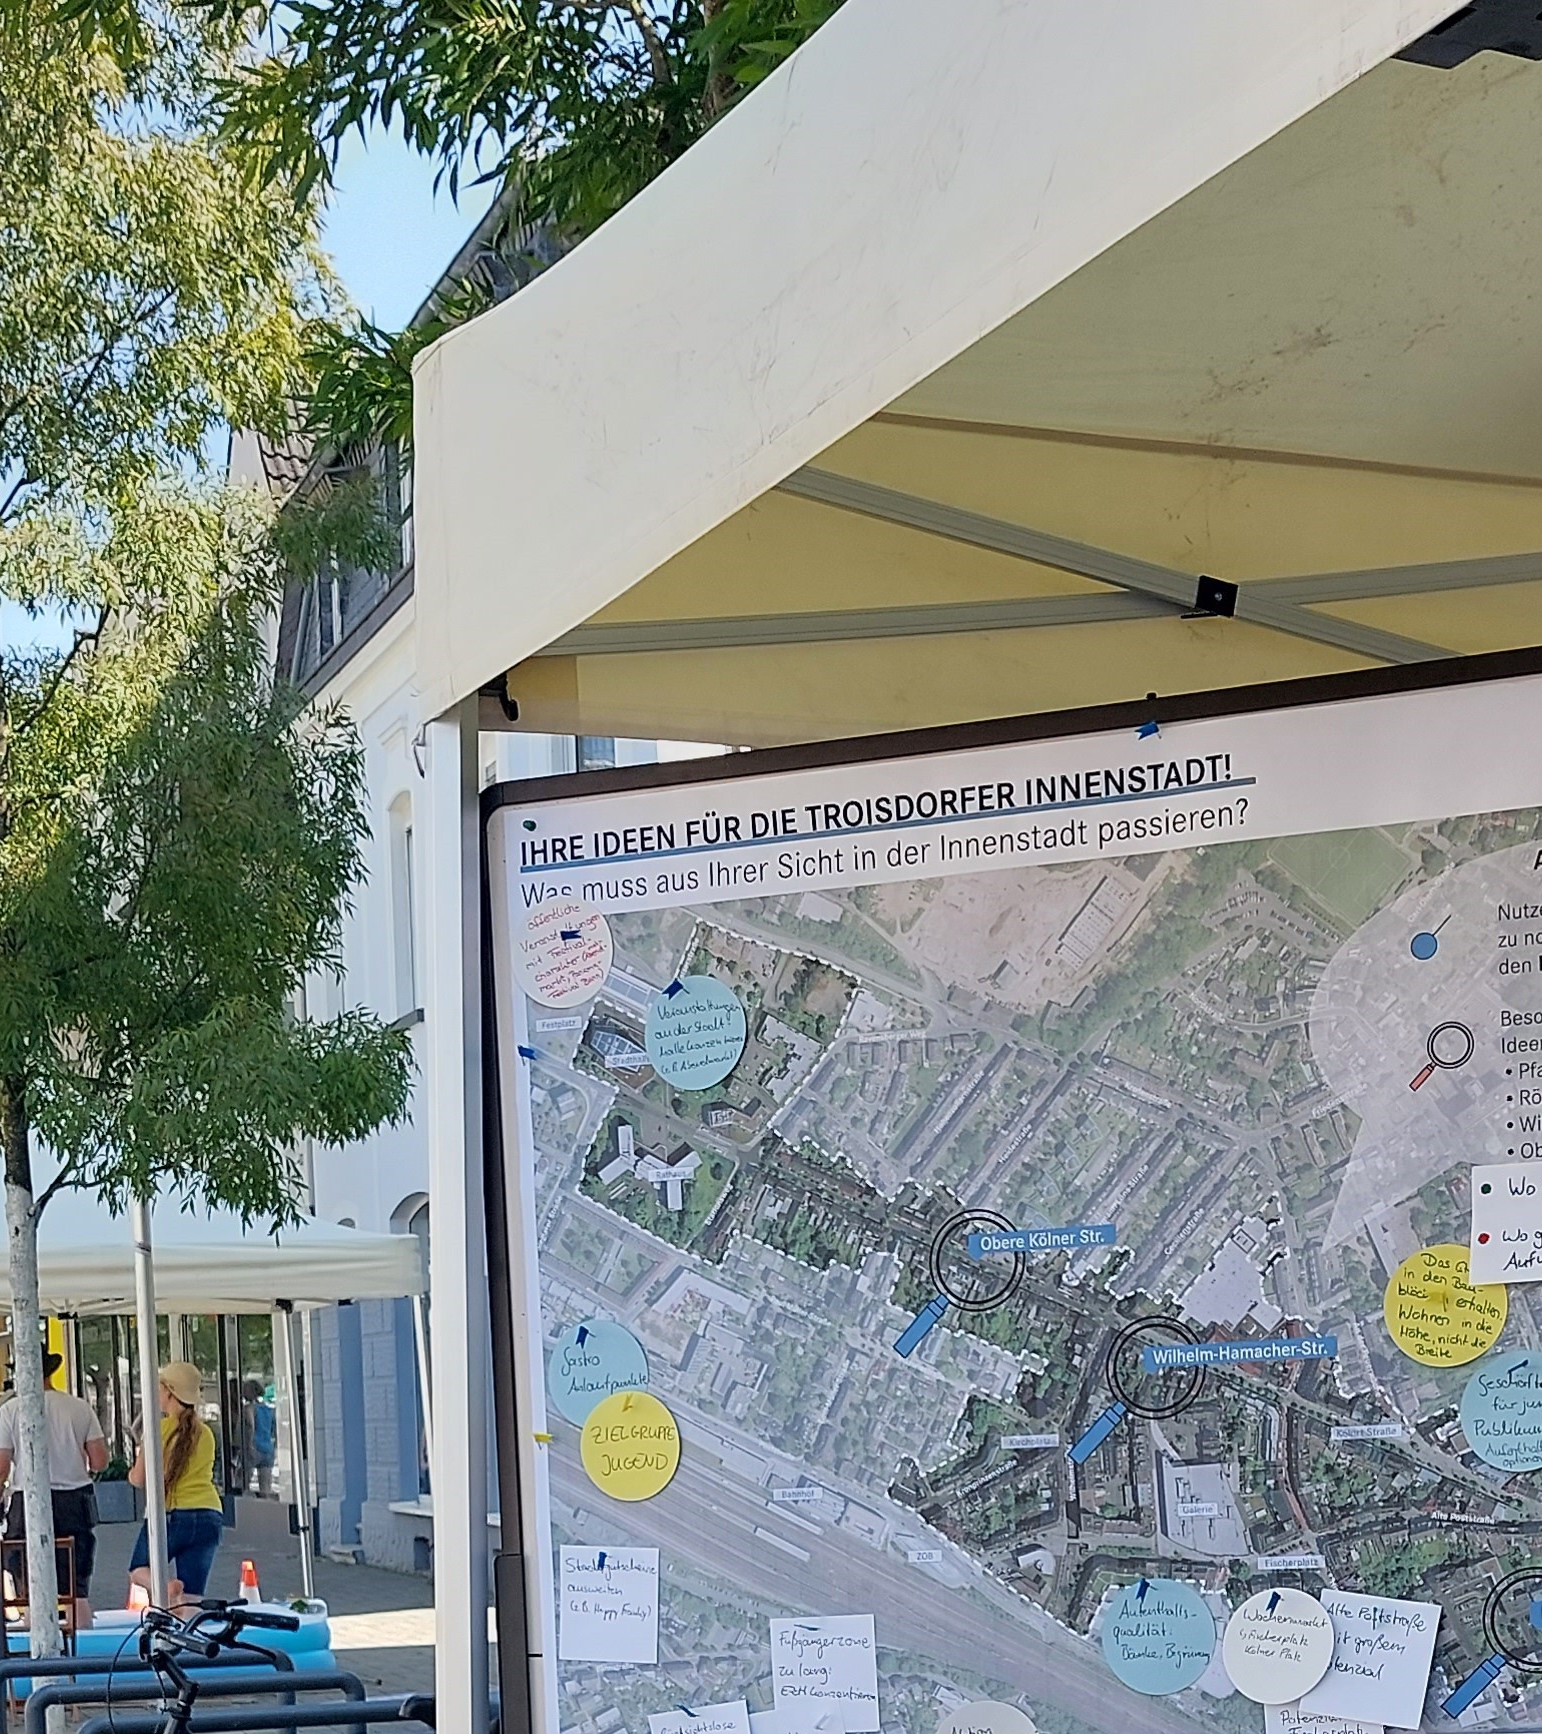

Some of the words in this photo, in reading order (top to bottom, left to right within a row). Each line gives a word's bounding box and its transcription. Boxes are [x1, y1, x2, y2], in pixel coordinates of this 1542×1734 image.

[521, 834, 585, 866] IHRE
[593, 823, 675, 858] IDEEN
[685, 811, 742, 847] FÜR
[751, 808, 797, 839] DIE
[805, 777, 1015, 832] TROISDORFER
[1026, 754, 1232, 805] INNENSTADT!
[582, 877, 647, 902] muss
[656, 870, 699, 894] aus
[709, 860, 769, 888] Ihrer
[778, 848, 844, 880] Sicht
[854, 845, 876, 871] in
[887, 841, 931, 868] der
[940, 819, 1087, 861] Innenstadt
[1099, 798, 1250, 850] passieren?
[1498, 932, 1518, 948] zu
[1499, 957, 1532, 975] den
[1508, 1177, 1536, 1196] Wo
[980, 1236, 1025, 1251] Obere
[1028, 1231, 1077, 1248] Kölner
[1080, 1228, 1105, 1244] Str.
[1502, 1229, 1529, 1243] Wo
[1420, 1252, 1450, 1269] Das
[1403, 1268, 1415, 1279] in
[1422, 1272, 1448, 1285] den
[1398, 1304, 1450, 1326] Wohnen
[1461, 1318, 1472, 1328] in
[1476, 1319, 1493, 1334] die
[1400, 1325, 1436, 1345] Höhe,
[1438, 1333, 1469, 1345] nicht
[1471, 1337, 1487, 1349] die
[1152, 1341, 1328, 1365] Wilhelm-Hamacher-Str.
[1415, 1344, 1452, 1358] Breite
[1491, 1396, 1515, 1411] für
[590, 1425, 676, 1444] ZIELGRUPPE
[601, 1453, 668, 1477] JUGEND
[1502, 1454, 1542, 1468] optionen
[781, 1489, 815, 1499] Bahnhof
[1327, 1603, 1354, 1619] Alte
